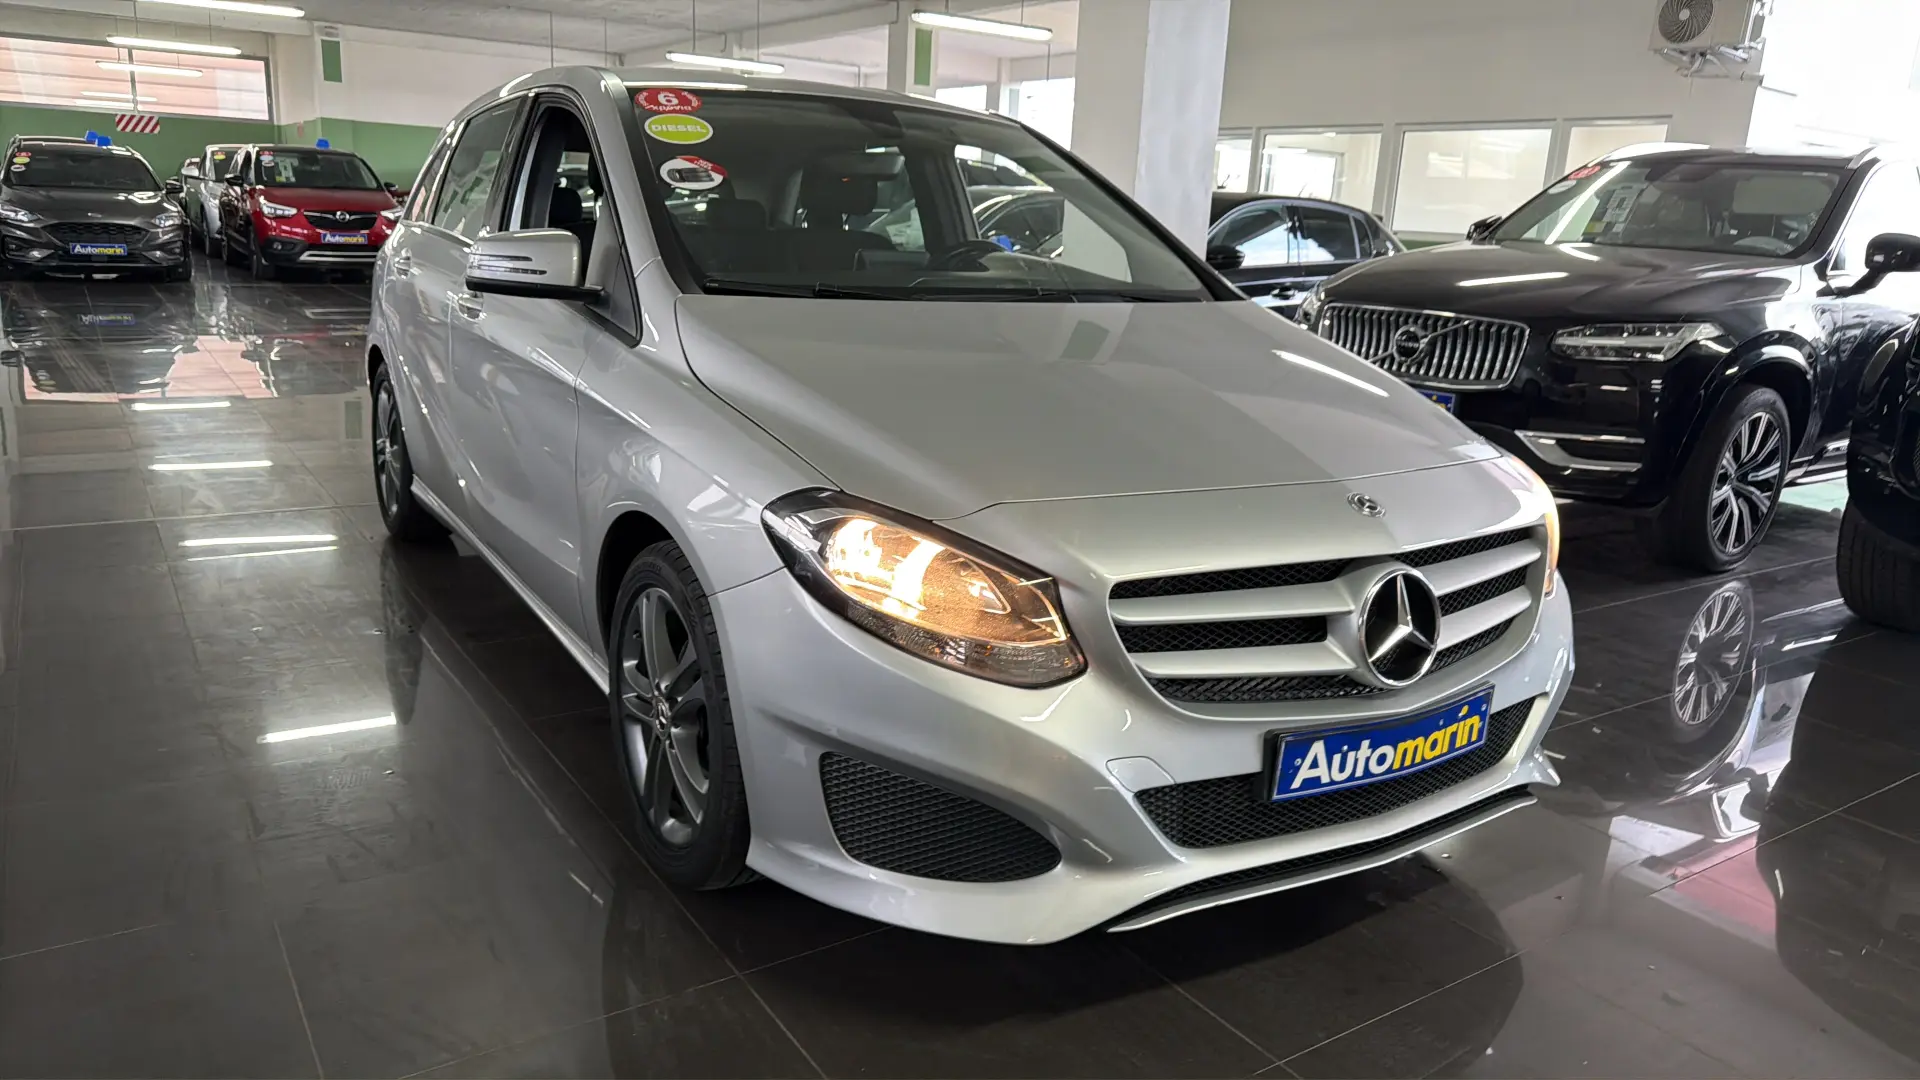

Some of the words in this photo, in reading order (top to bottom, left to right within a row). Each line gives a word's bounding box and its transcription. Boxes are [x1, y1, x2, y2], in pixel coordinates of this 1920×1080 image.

[658, 92, 679, 106] 6
[651, 124, 707, 133] DIESEL
[325, 233, 365, 243] Automarin
[74, 244, 124, 254] Automarin
[1290, 705, 1481, 790] Automarin
